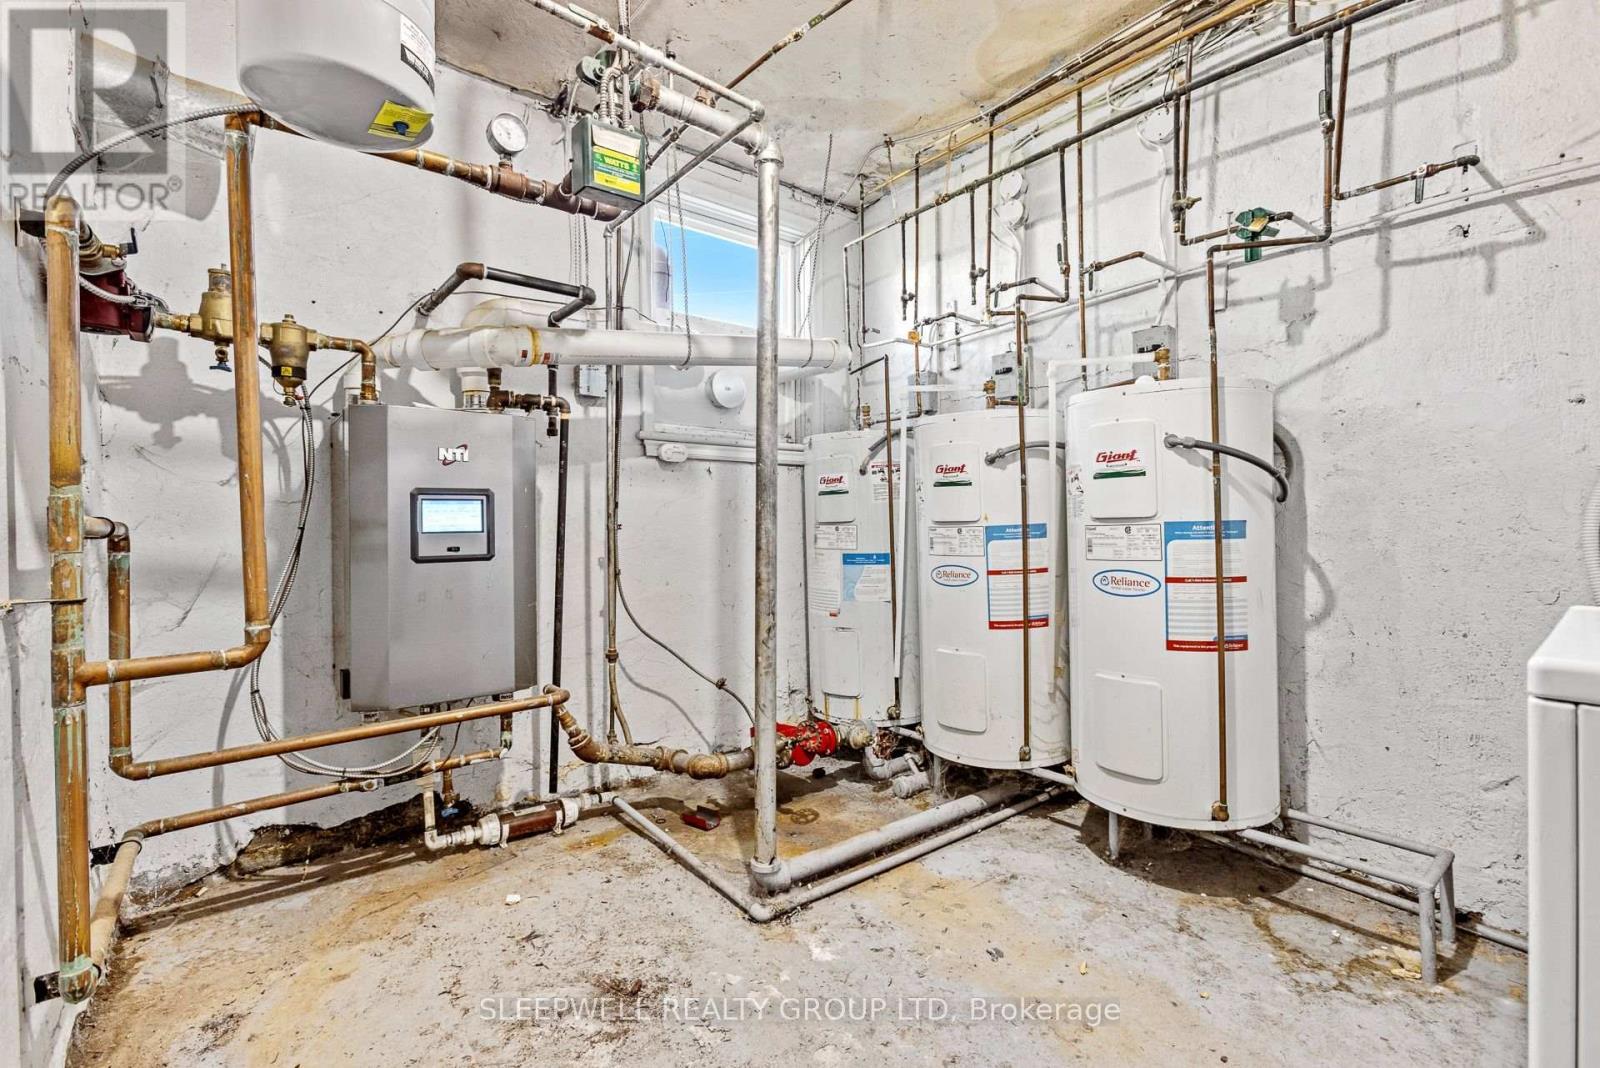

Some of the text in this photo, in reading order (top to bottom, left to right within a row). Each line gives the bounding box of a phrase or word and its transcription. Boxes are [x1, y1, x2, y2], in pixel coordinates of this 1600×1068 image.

[438, 447, 469, 461] NTI
[1095, 449, 1139, 463] Giant
[935, 463, 968, 474] Giant
[819, 475, 845, 485] Giant
[942, 570, 972, 579] Reliance
[1110, 575, 1151, 588] Reliance
